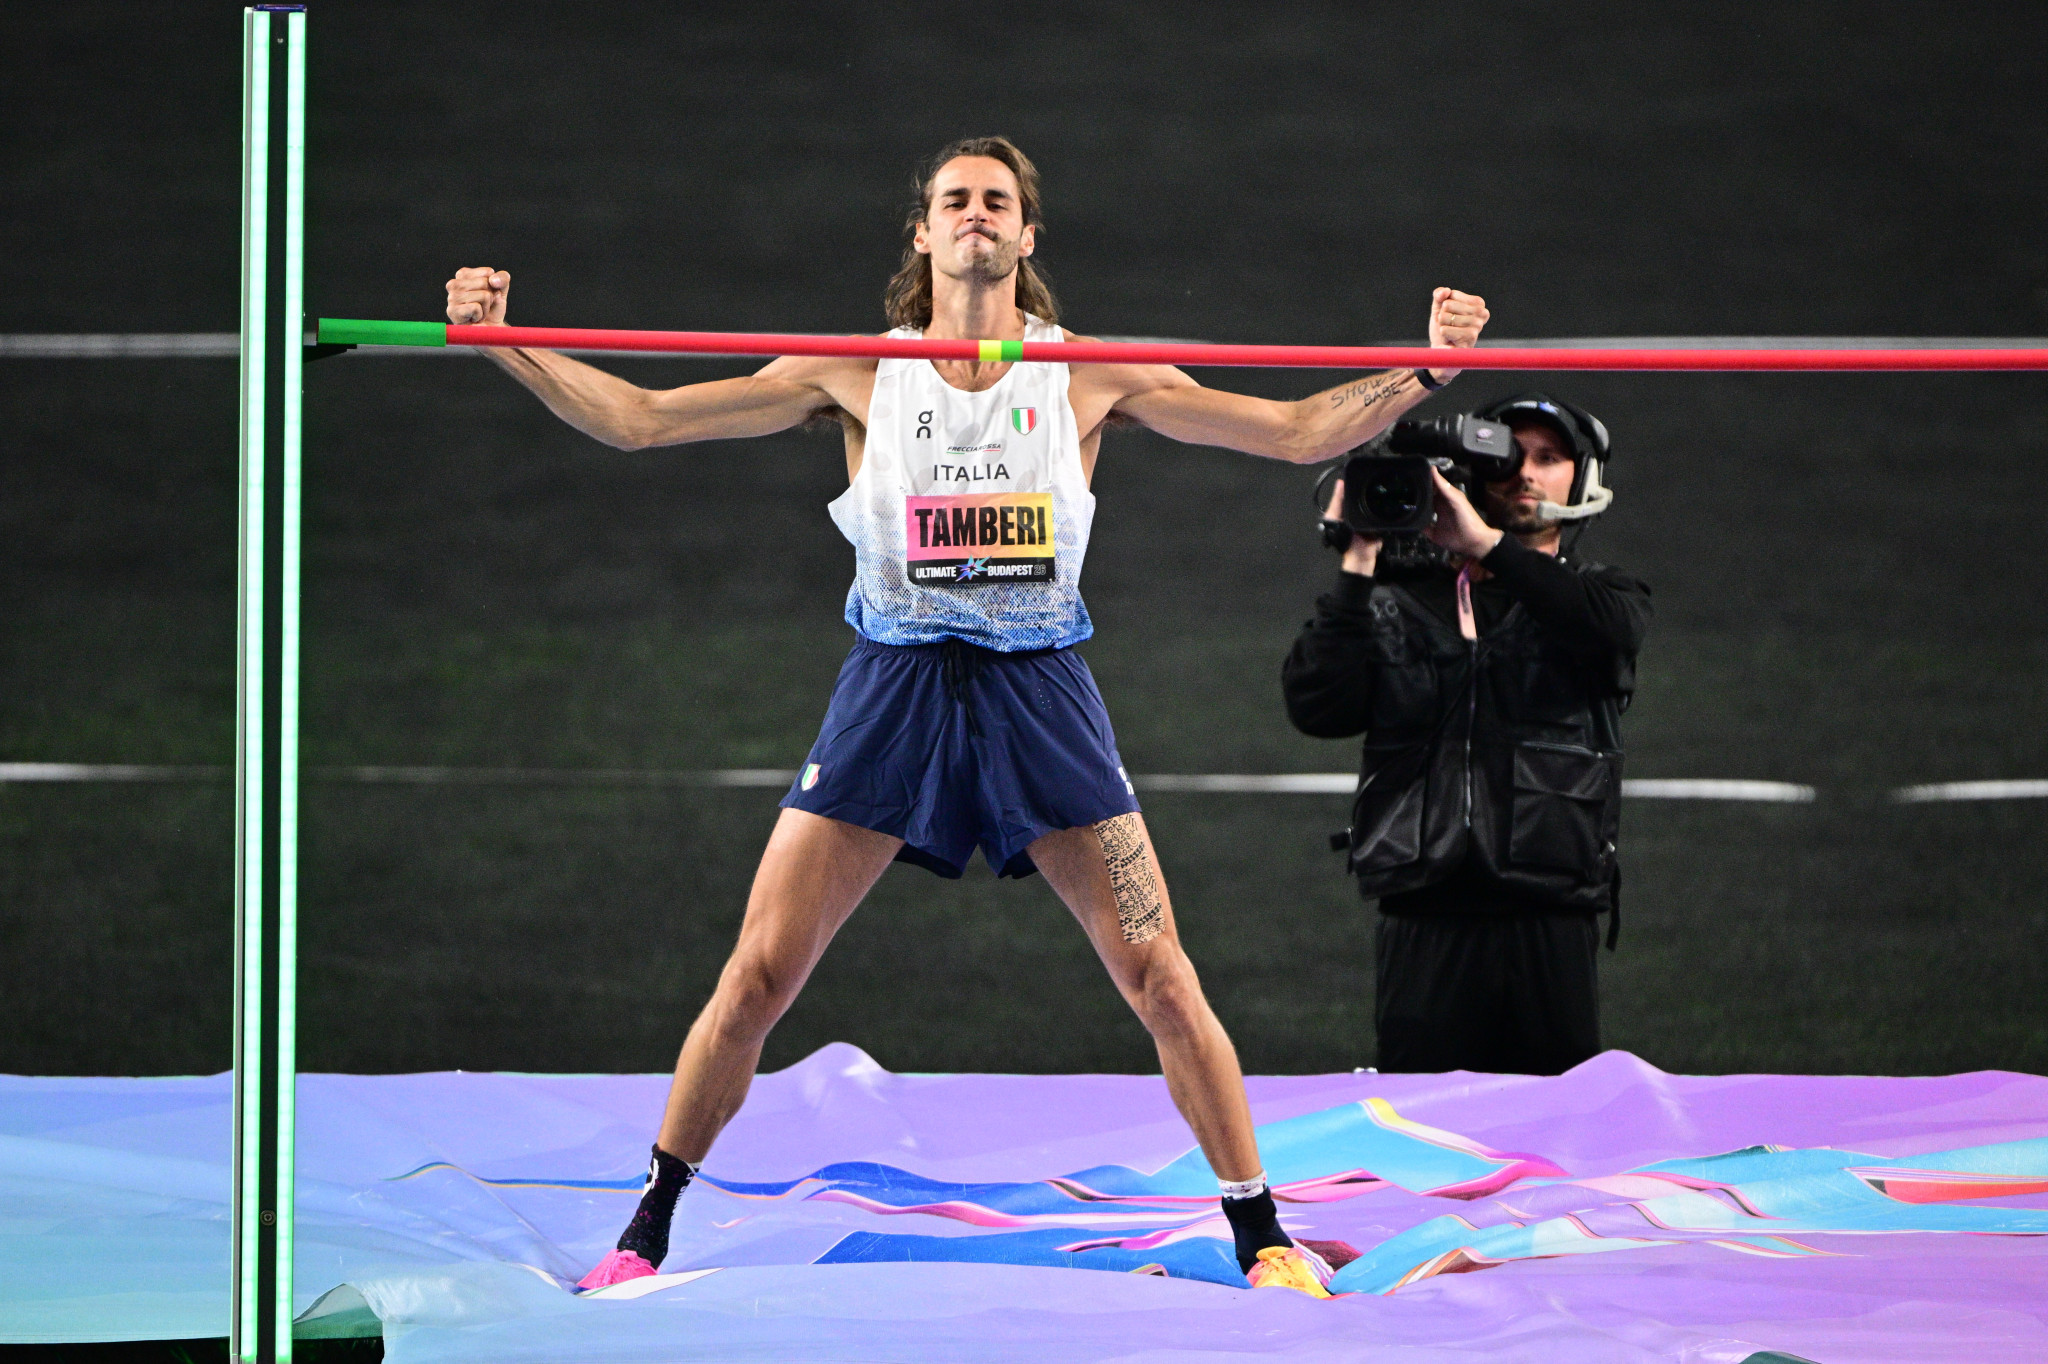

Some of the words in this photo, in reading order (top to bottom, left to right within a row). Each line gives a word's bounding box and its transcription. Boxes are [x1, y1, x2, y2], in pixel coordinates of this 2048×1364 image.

[1364, 382, 1401, 407] BABE
[933, 463, 1011, 482] ITALIA
[914, 506, 1047, 548] TAMBERI
[915, 566, 957, 579] ULTIMATE
[987, 564, 1033, 577] BUDAPEST
